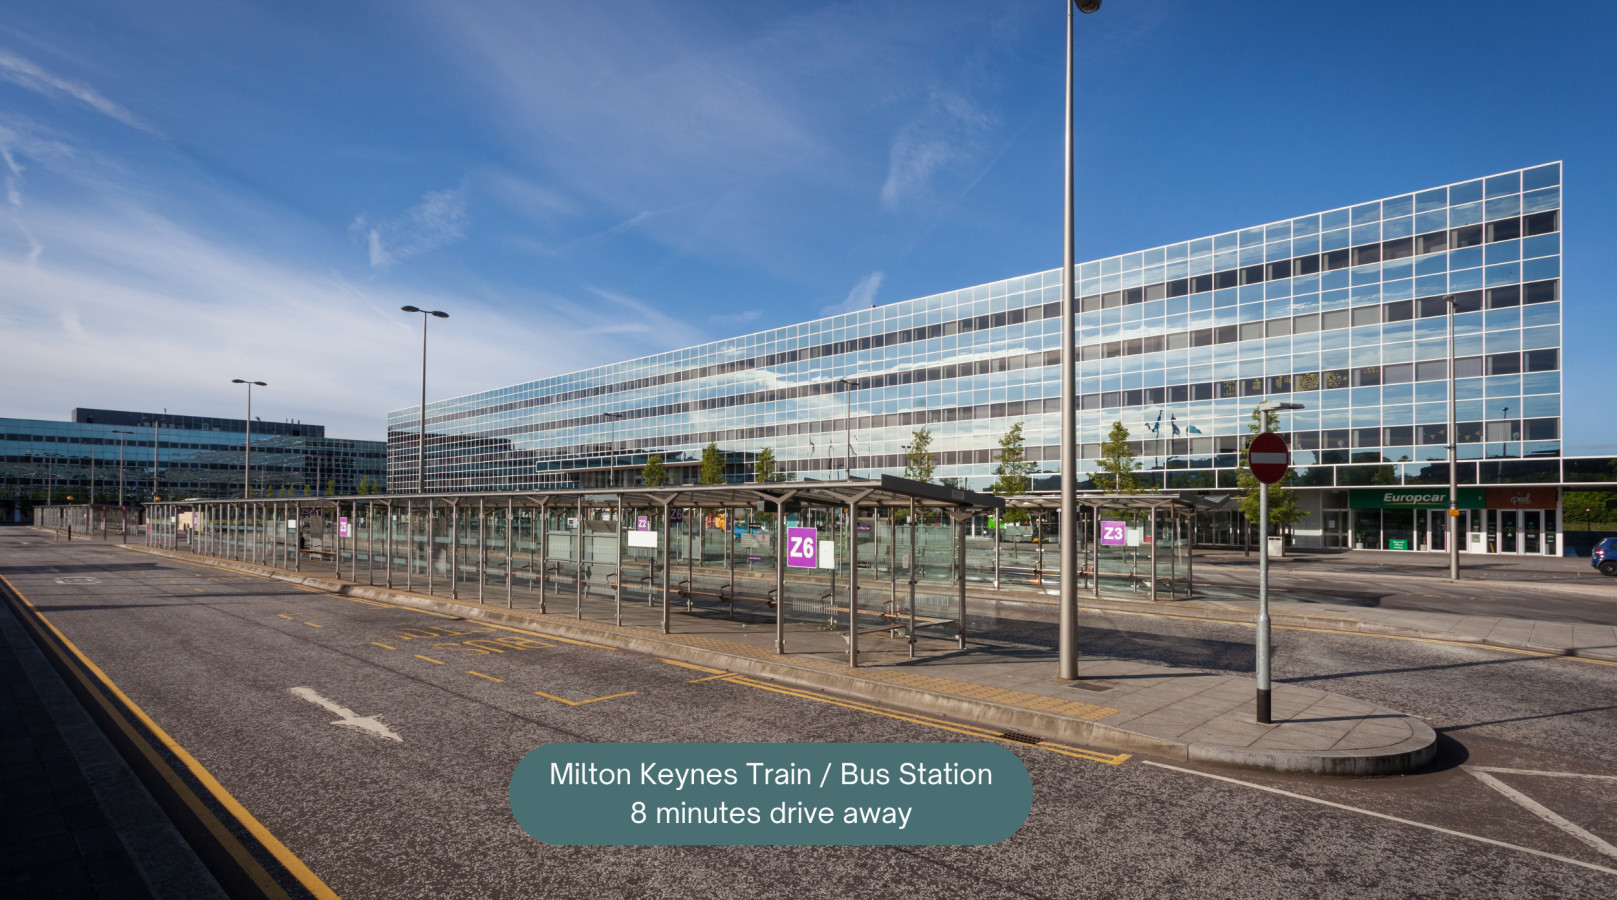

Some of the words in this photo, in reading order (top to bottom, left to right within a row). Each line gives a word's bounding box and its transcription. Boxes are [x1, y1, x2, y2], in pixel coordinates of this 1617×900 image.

[1383, 493, 1447, 505] Europcar
[638, 519, 647, 528] Z2
[1103, 526, 1123, 540] Z3
[790, 536, 814, 559] Z6
[432, 636, 557, 657] BUS
